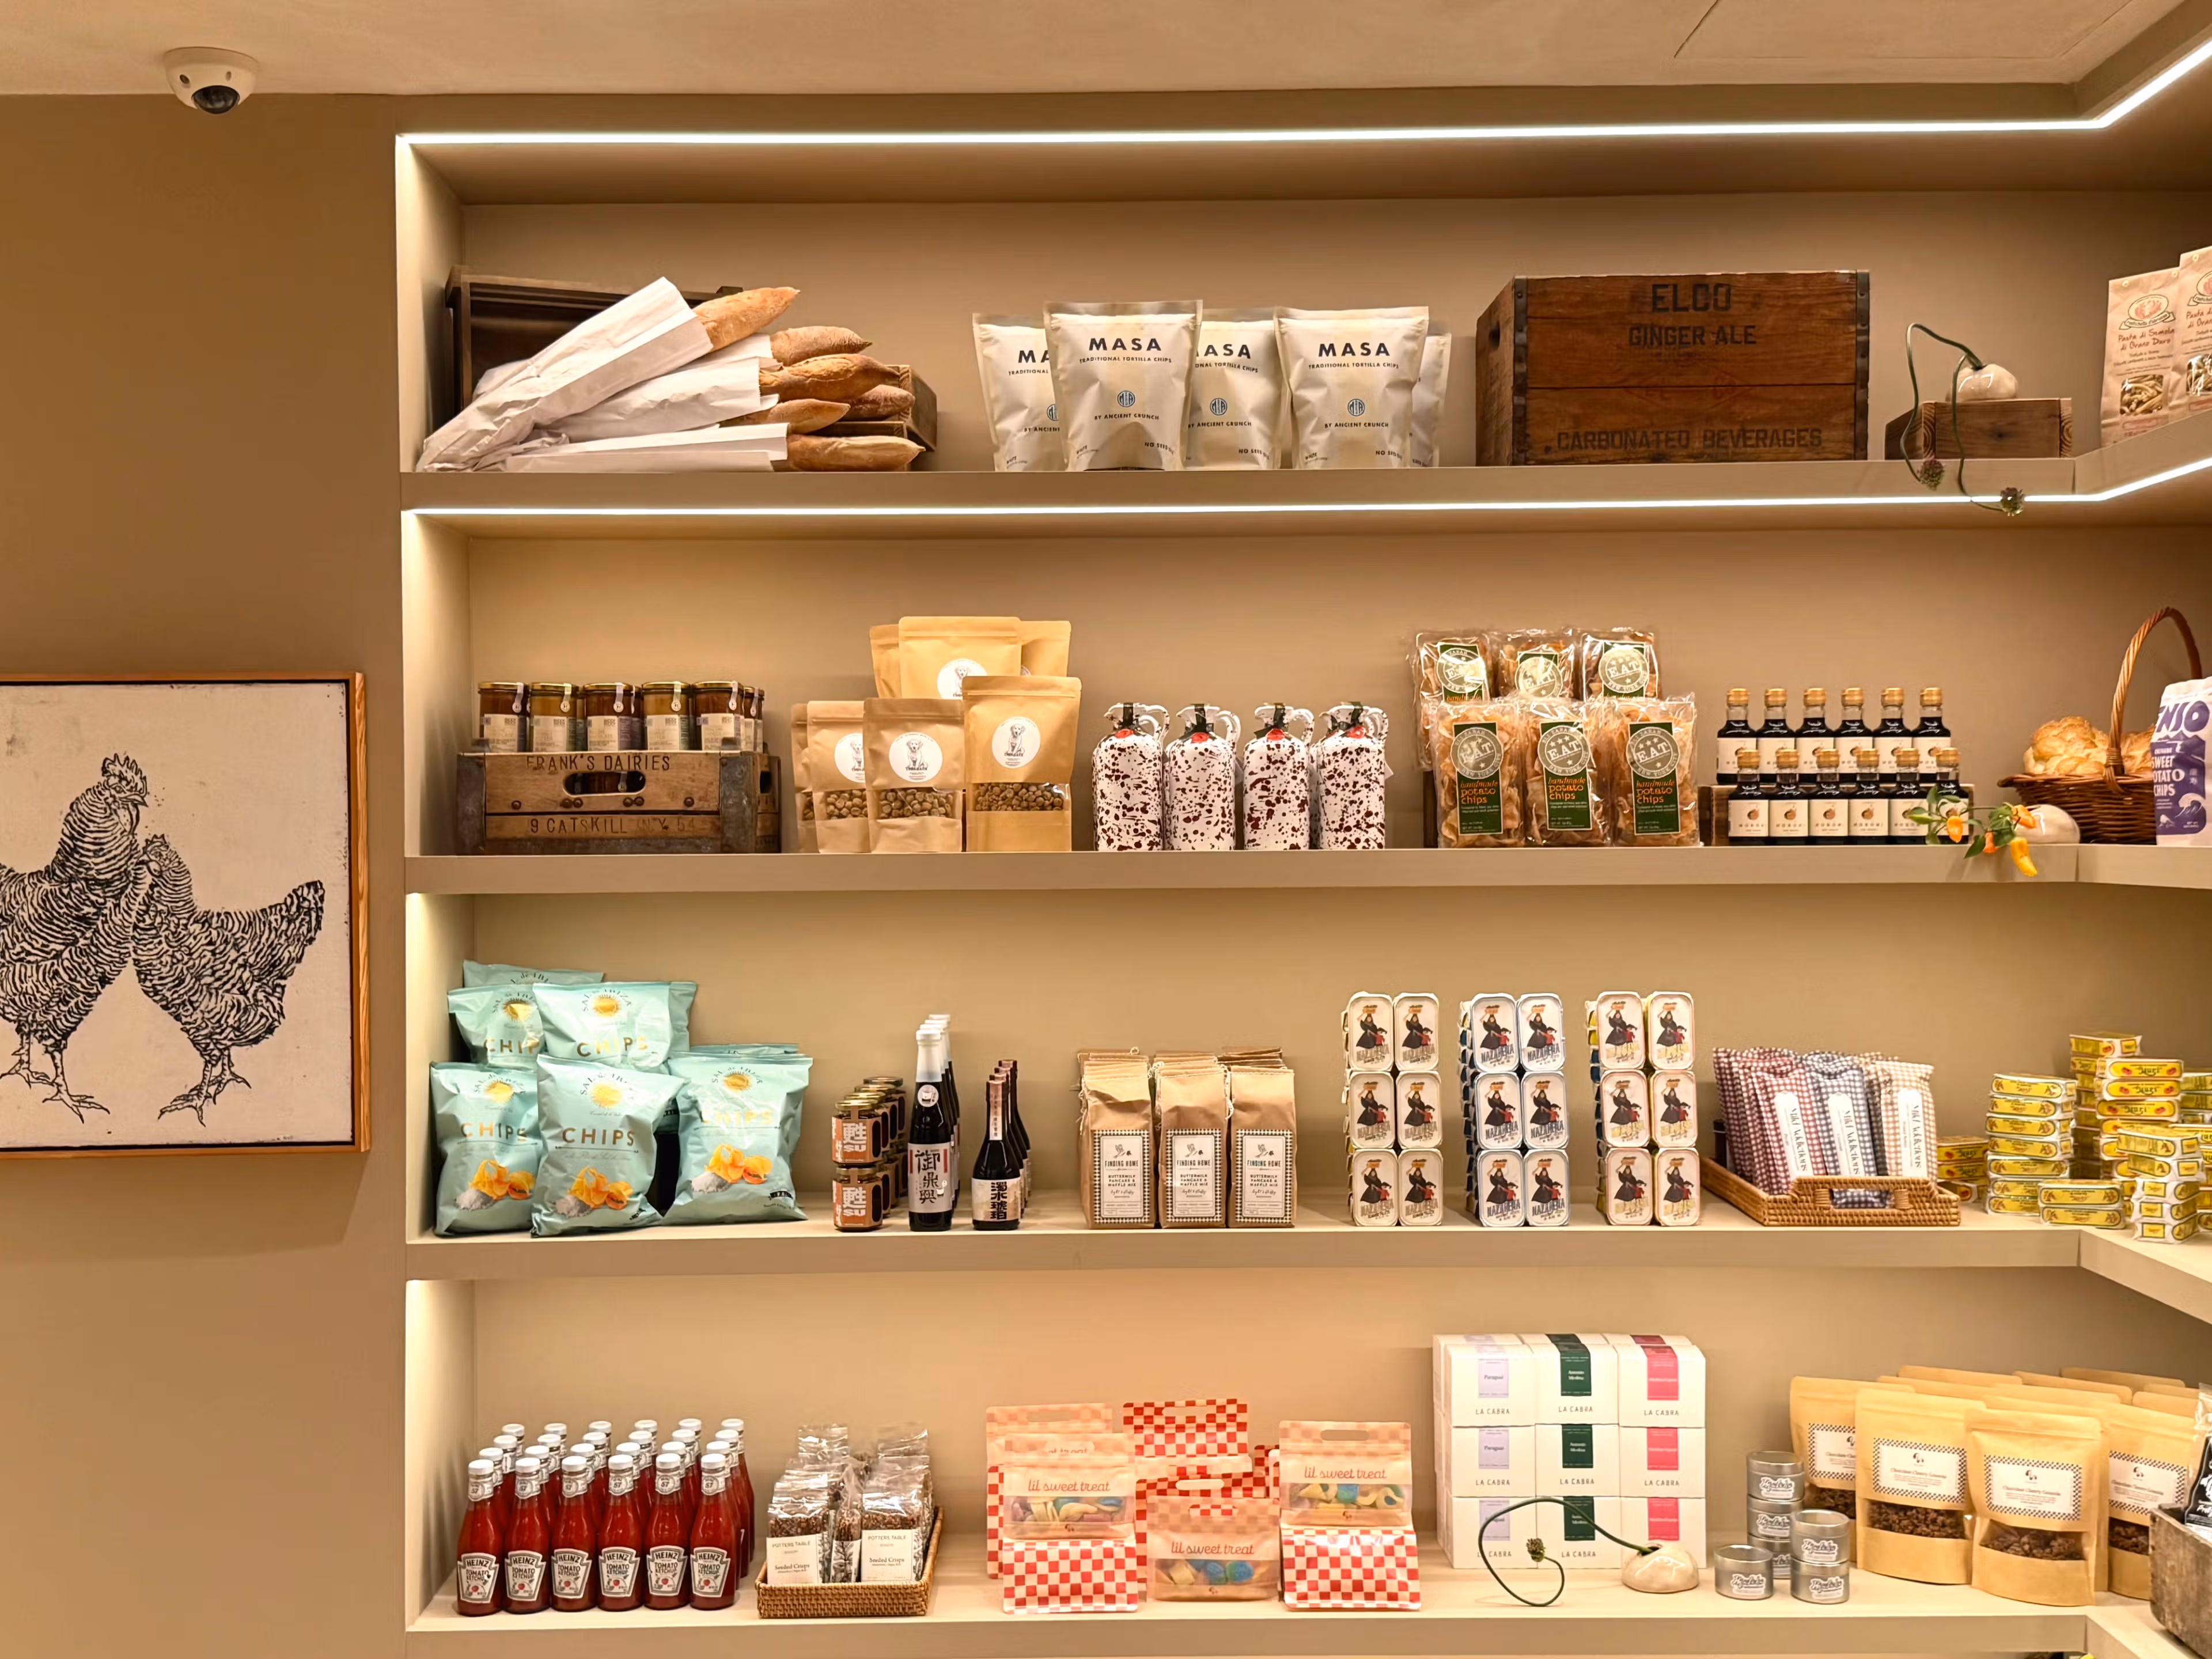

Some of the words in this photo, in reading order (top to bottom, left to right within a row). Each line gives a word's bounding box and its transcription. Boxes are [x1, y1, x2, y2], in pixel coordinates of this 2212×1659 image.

[1652, 283, 1732, 313] ELCO
[1628, 326, 1706, 346] GINGER
[1715, 325, 1757, 344] ALE
[1088, 338, 1162, 351] MASA
[1318, 342, 1390, 357] MASA
[1196, 344, 1251, 359] ASA
[1557, 430, 1690, 451] CARBONATED
[1703, 428, 1823, 449] BEVERAGES
[527, 755, 595, 771] FRANK'S
[604, 755, 671, 771] DAIRIES
[1460, 779, 1498, 789] handmade
[1548, 784, 1584, 793] potato
[1637, 779, 1675, 788] handmade
[1461, 788, 1496, 798] potato
[1549, 792, 1576, 801] chips
[1636, 787, 1673, 797] potato
[2154, 784, 2175, 797] CHIPS
[1461, 796, 1487, 805] chips
[1637, 796, 1664, 805] chips
[547, 817, 627, 834] CATSKILL
[577, 1036, 649, 1057] CHIPS
[461, 1122, 528, 1143] CHIPS
[562, 1127, 637, 1147] CHIPS
[1794, 1129, 1808, 1172] Addictions
[1847, 1131, 1860, 1175] Addictions
[1912, 1126, 1922, 1168] Addictions
[915, 1150, 940, 1204] 御鼎興
[991, 1181, 1007, 1220] 濁水琥珀
[1304, 1465, 1316, 1479] lil
[1320, 1467, 1354, 1479] sweet
[1356, 1467, 1387, 1479] treat
[1028, 1479, 1040, 1492] lil
[1043, 1480, 1078, 1492] sweet
[1080, 1480, 1111, 1492] treat
[1171, 1541, 1184, 1555] lil
[1186, 1543, 1220, 1555] sweet
[1222, 1542, 1254, 1555] treat
[467, 1559, 490, 1567] HEINZ
[513, 1557, 536, 1565] HEINZ
[558, 1555, 581, 1563] HEINZ
[606, 1553, 630, 1561] HEINZ
[698, 1554, 721, 1562] HEINZ
[888, 1556, 904, 1565] Crisps
[793, 1563, 810, 1571] Crisps
